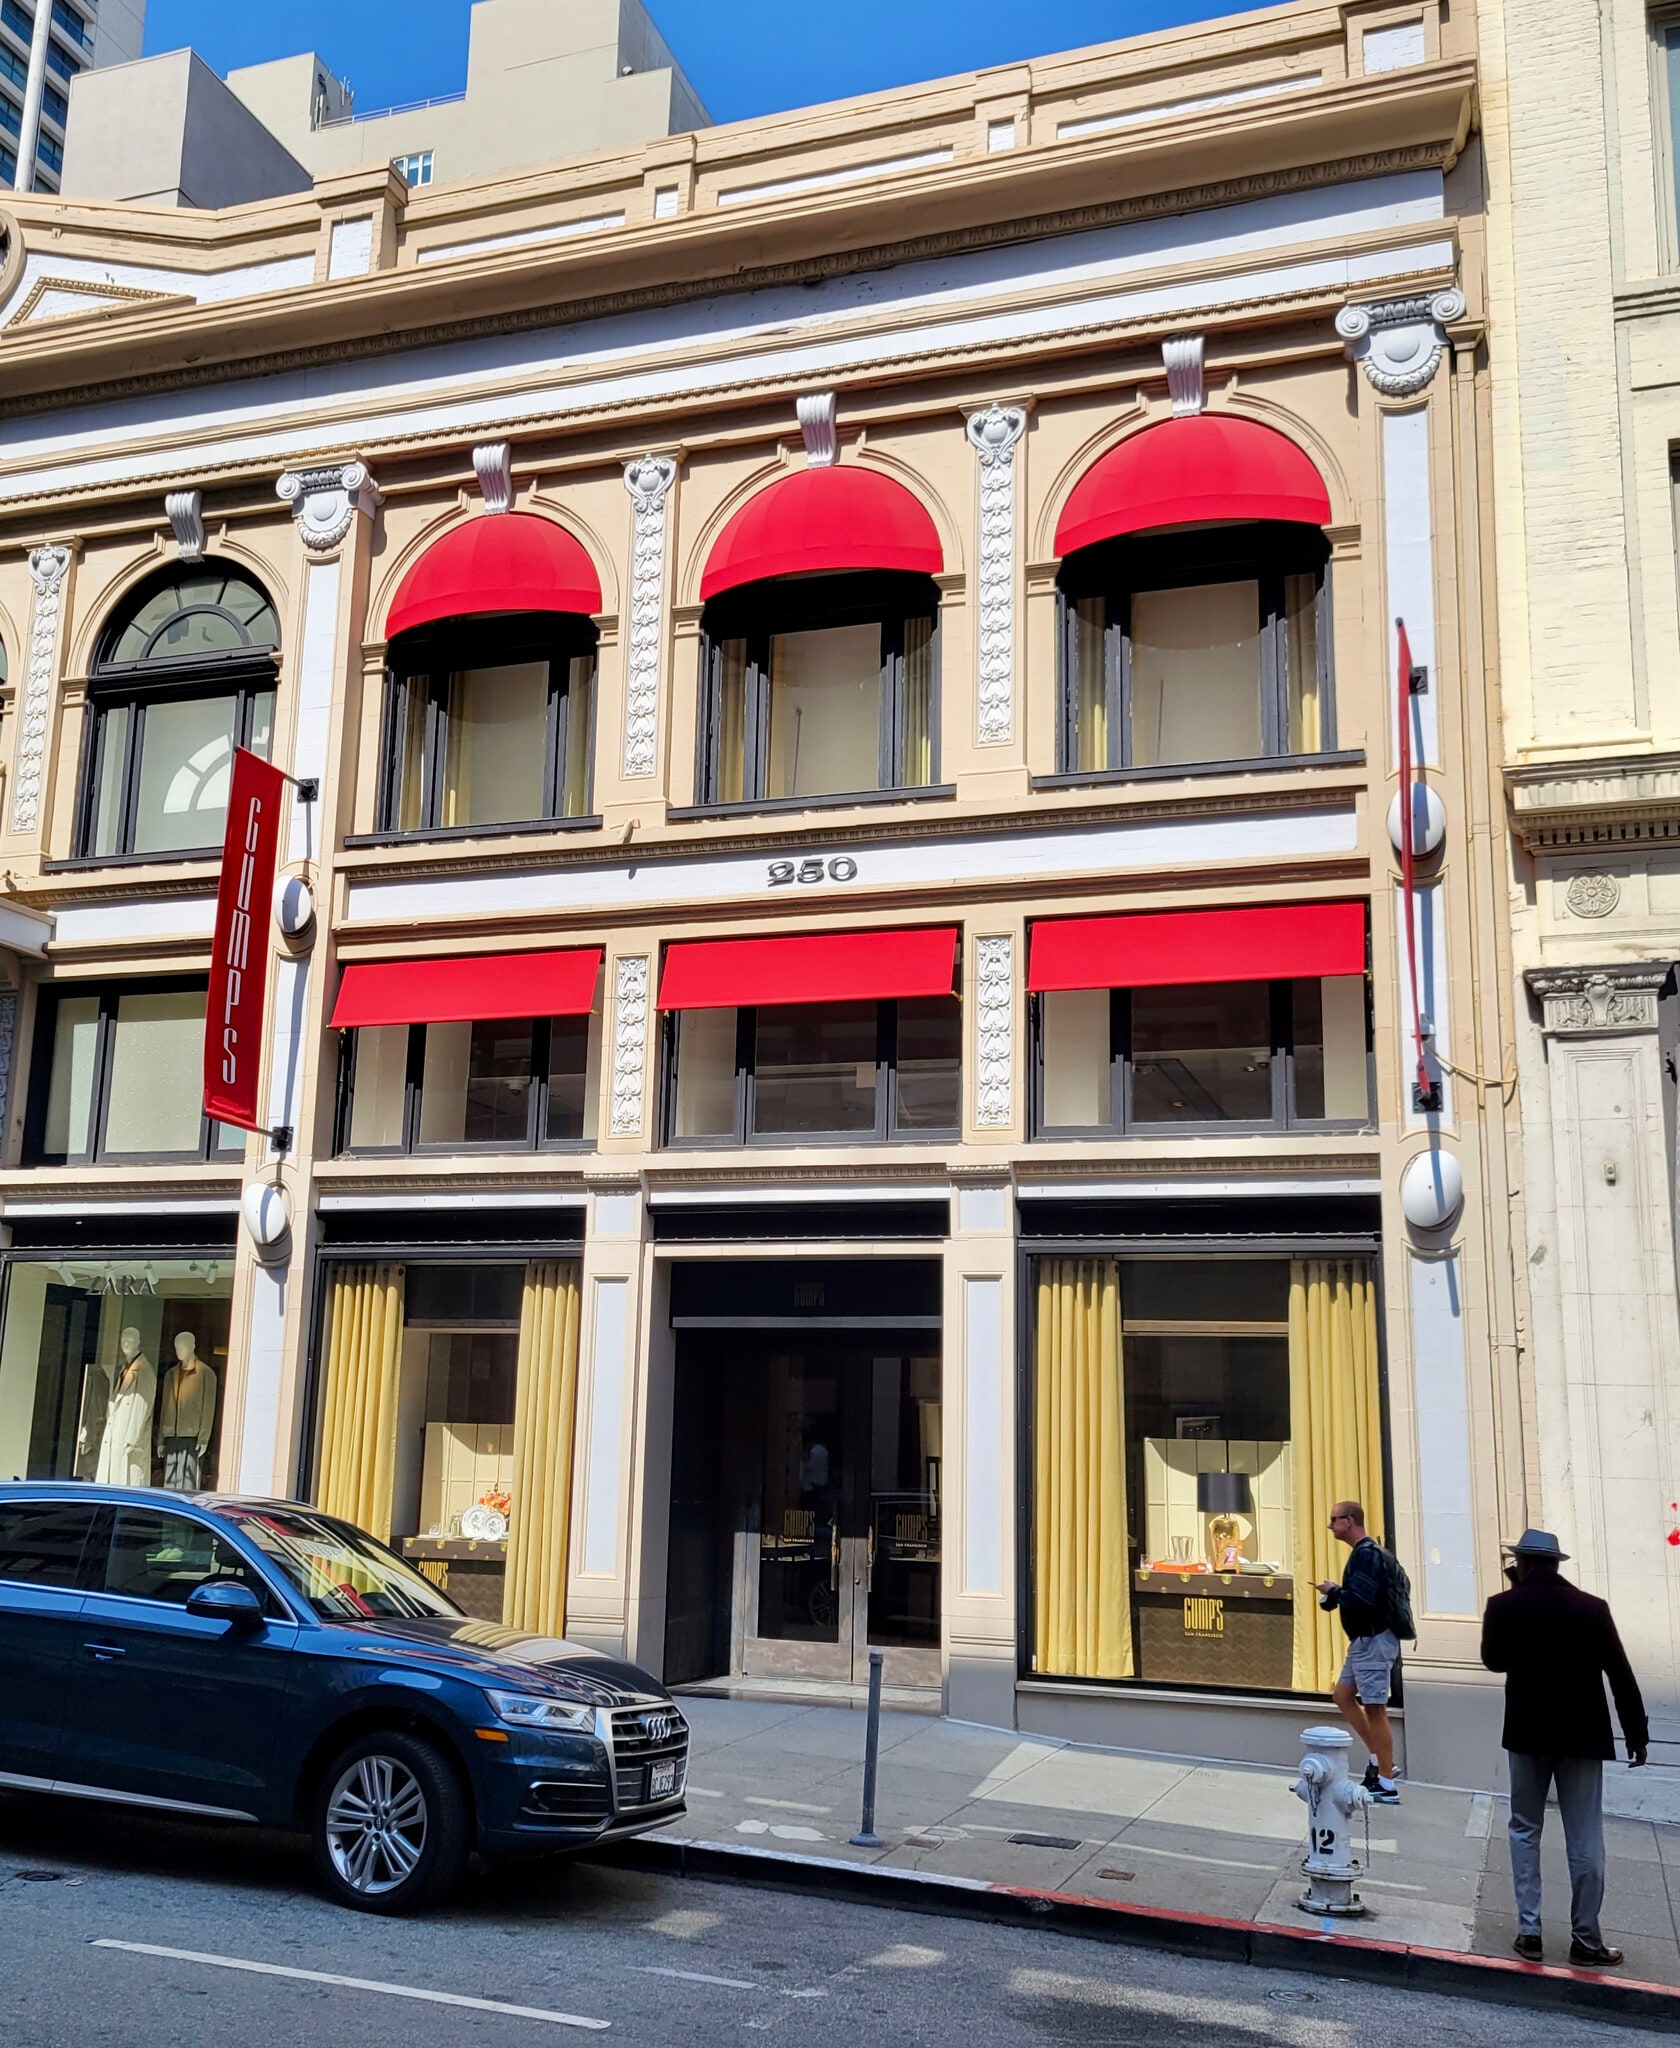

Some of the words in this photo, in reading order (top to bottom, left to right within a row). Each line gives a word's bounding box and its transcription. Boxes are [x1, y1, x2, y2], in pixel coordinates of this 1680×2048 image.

[766, 856, 858, 888] 250
[222, 796, 262, 1085] GUMPS
[85, 1273, 157, 1296] ZARA
[1184, 1597, 1224, 1631] GUMP'S
[1311, 1826, 1335, 1855] 12
